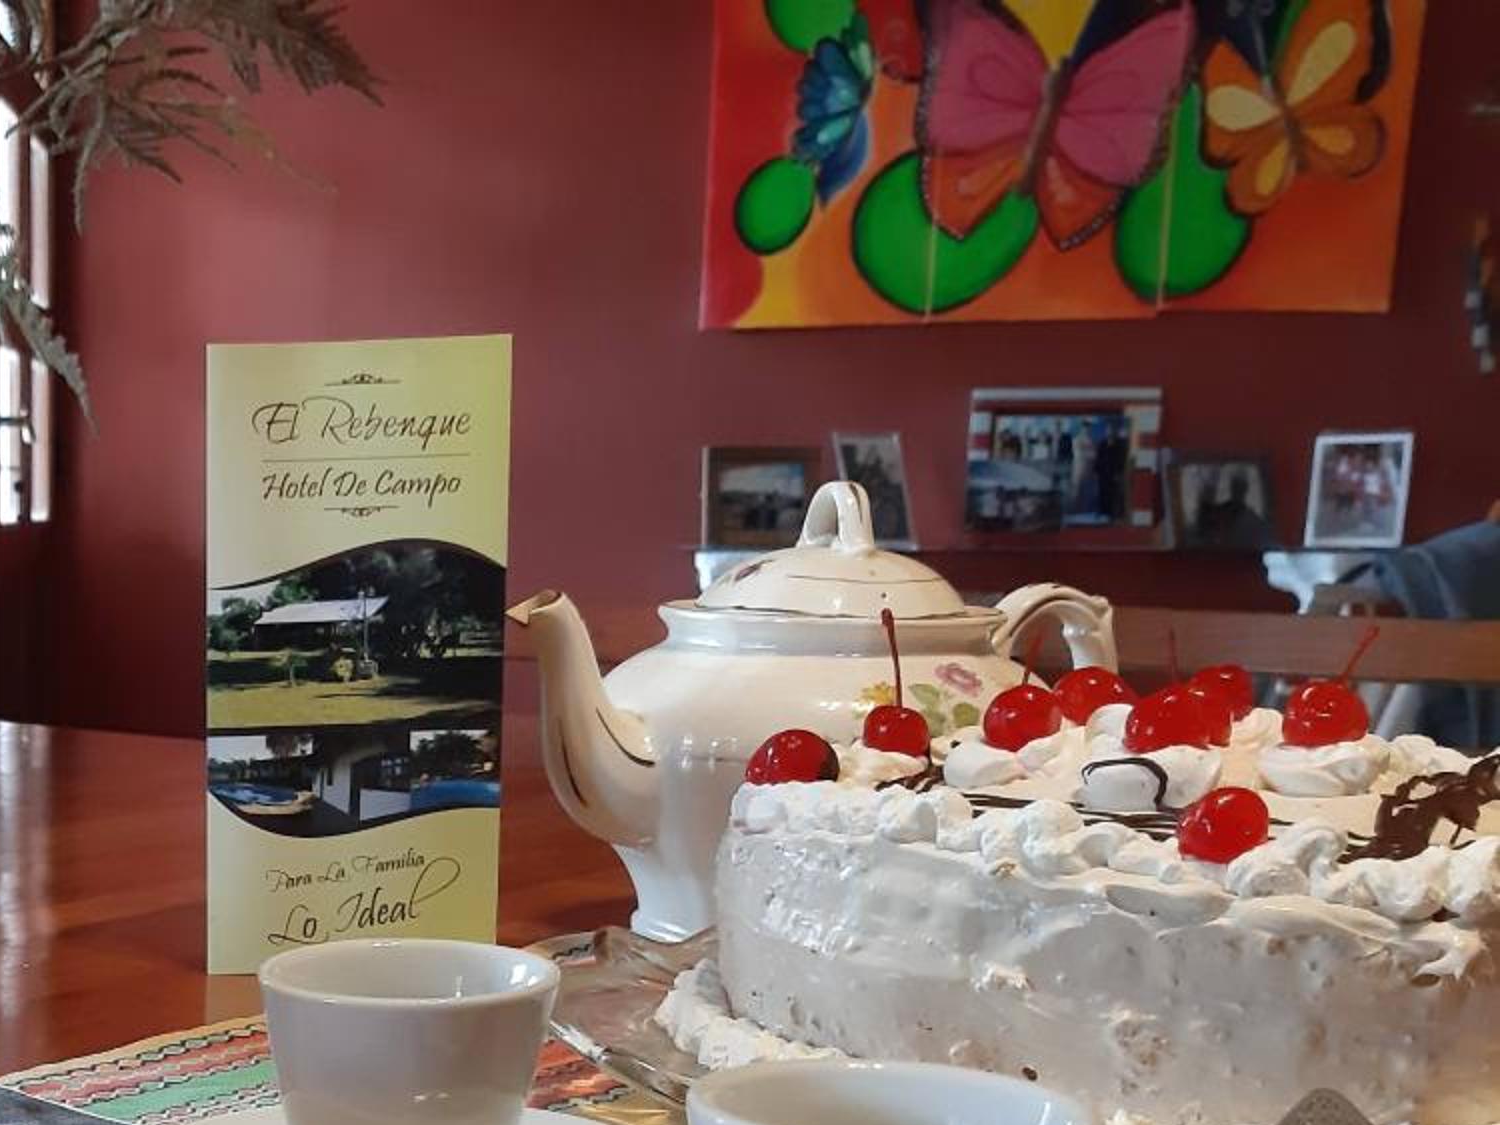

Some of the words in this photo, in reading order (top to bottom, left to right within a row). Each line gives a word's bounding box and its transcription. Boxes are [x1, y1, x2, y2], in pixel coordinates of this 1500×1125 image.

[251, 401, 301, 444] El
[302, 395, 471, 451] Rebenque
[261, 467, 333, 499] Hotel
[333, 471, 367, 498] De
[374, 469, 461, 507] Campo
[265, 868, 312, 893] Para
[317, 861, 345, 882] La
[351, 847, 425, 874] Familia
[267, 903, 329, 945] Lo
[334, 856, 461, 933] Ideal
